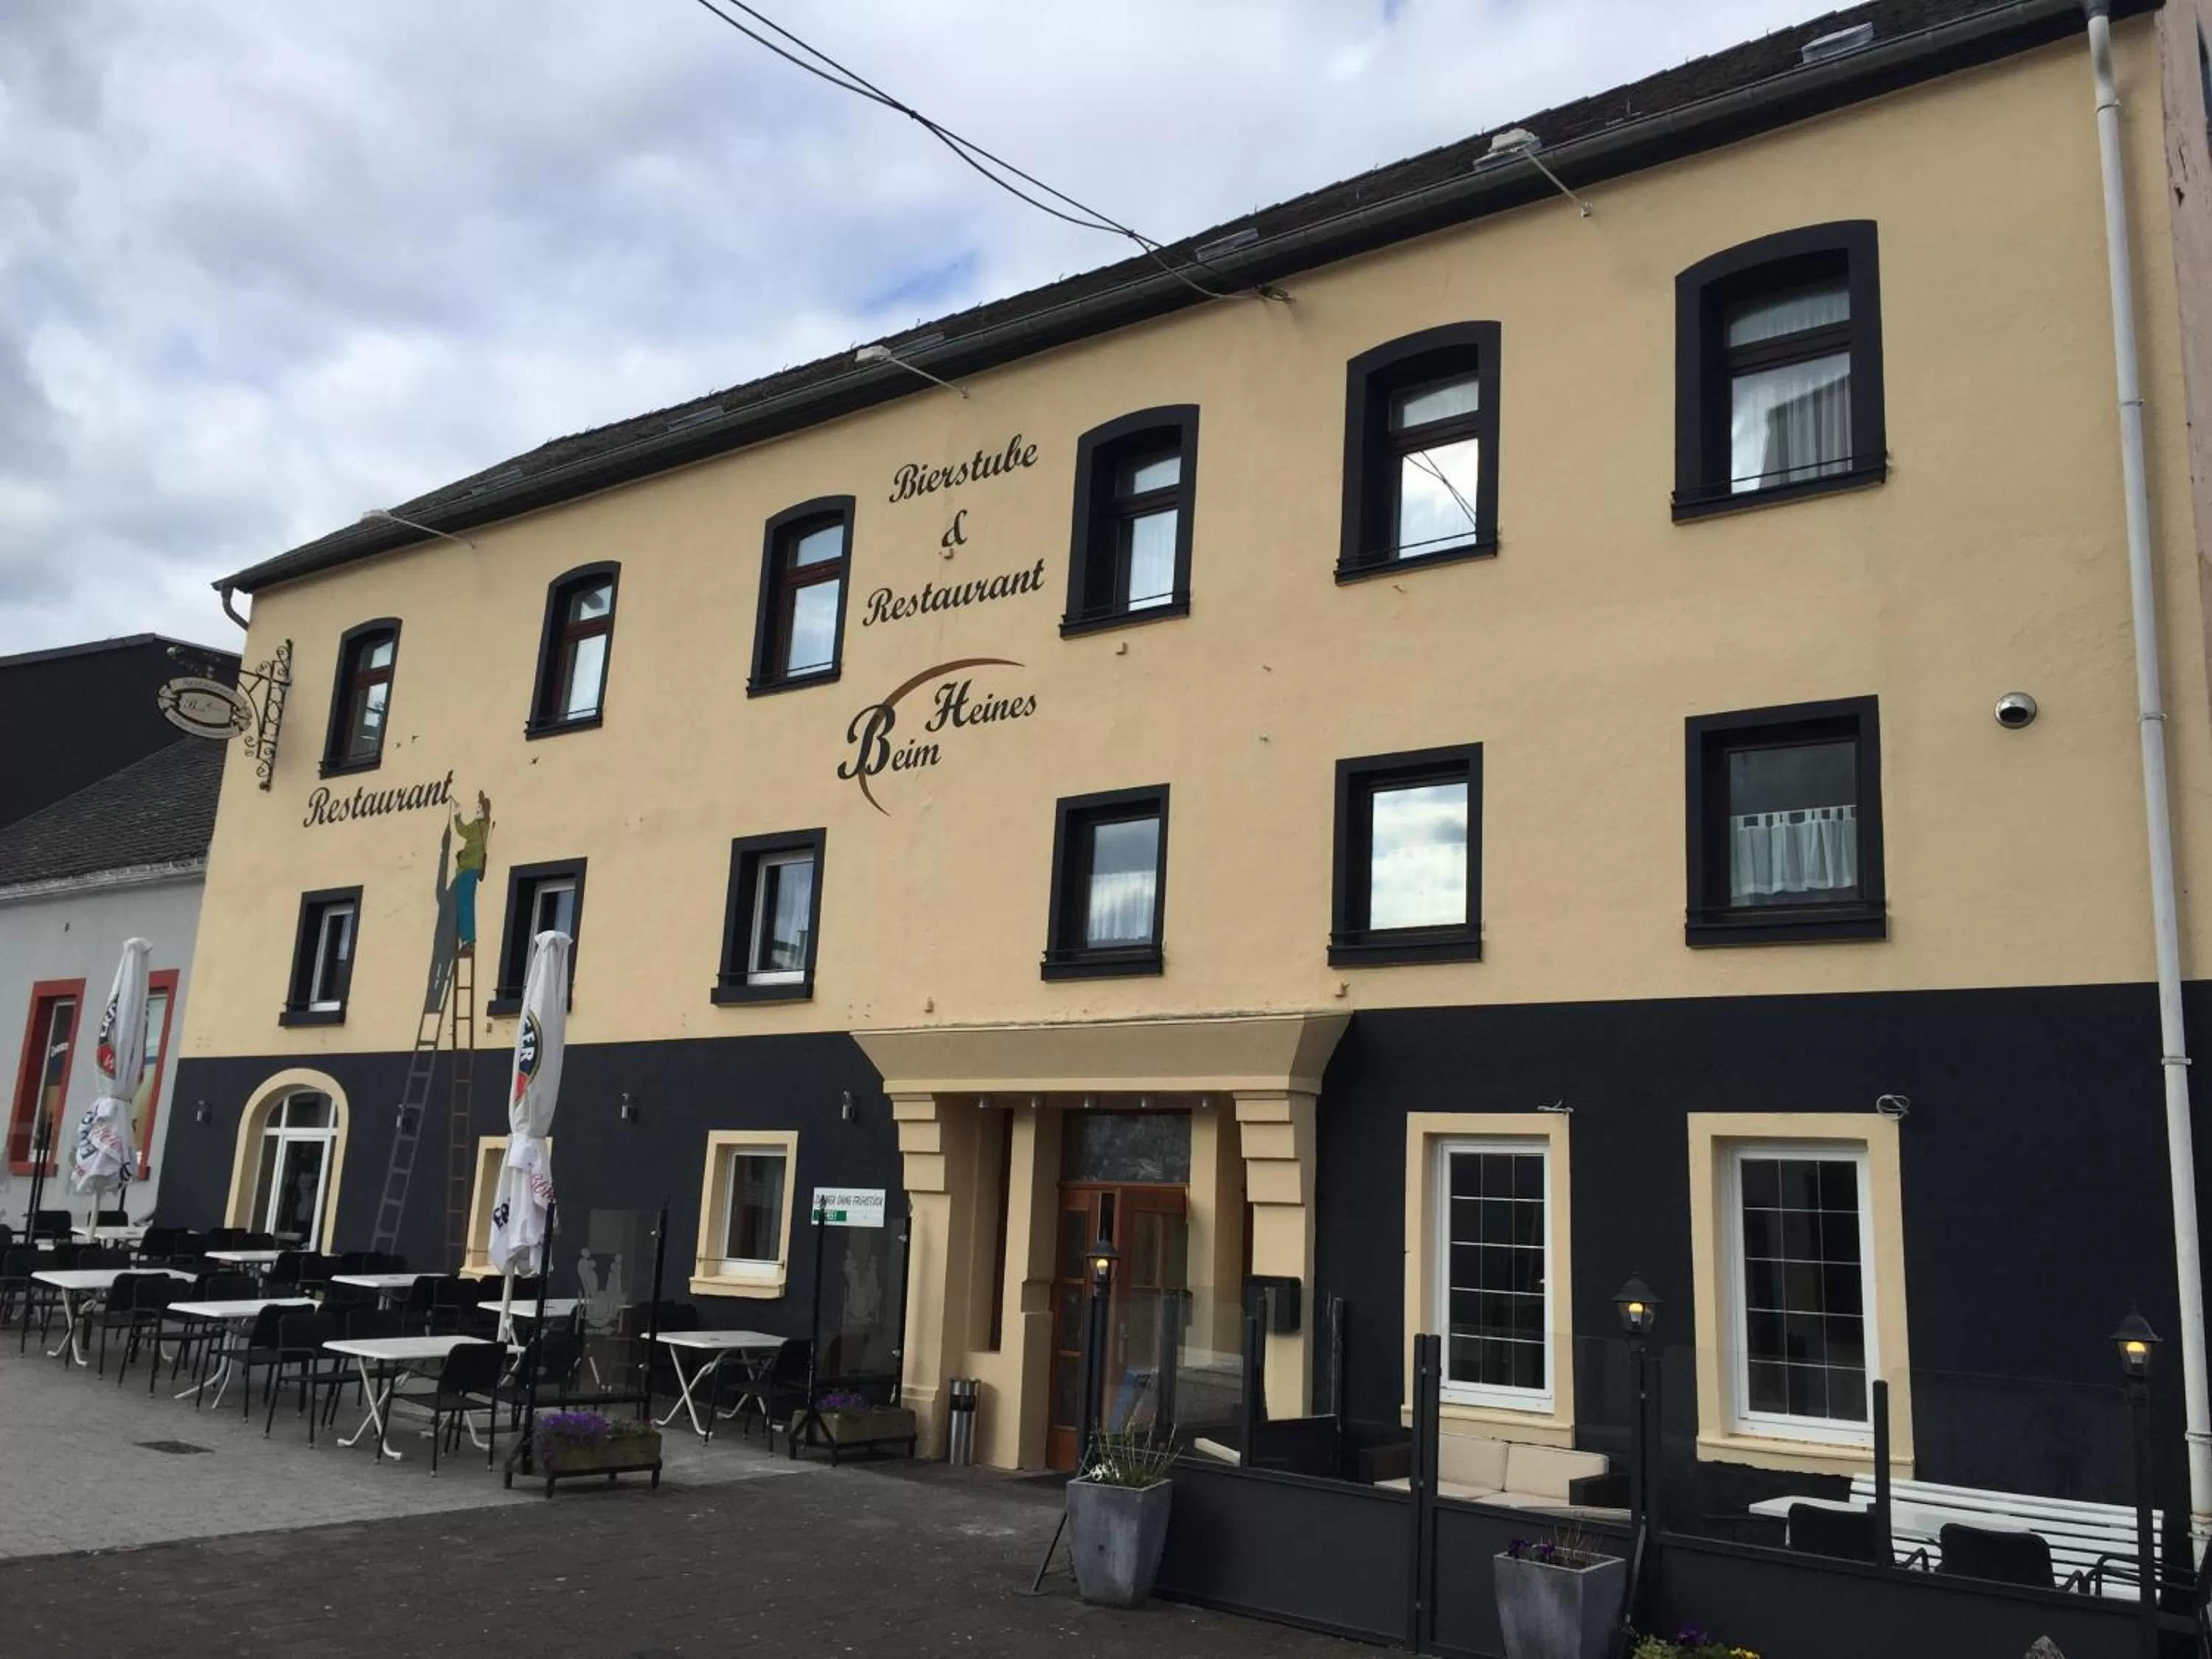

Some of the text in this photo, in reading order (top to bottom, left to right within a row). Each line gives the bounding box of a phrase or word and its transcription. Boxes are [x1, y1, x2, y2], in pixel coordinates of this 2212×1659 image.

[889, 434, 1038, 503] Bierstube
[941, 509, 968, 548] &
[863, 559, 1045, 627] Restaurant
[925, 678, 1036, 733] Heines
[838, 704, 941, 779] Beim
[303, 770, 454, 827] Restaurant
